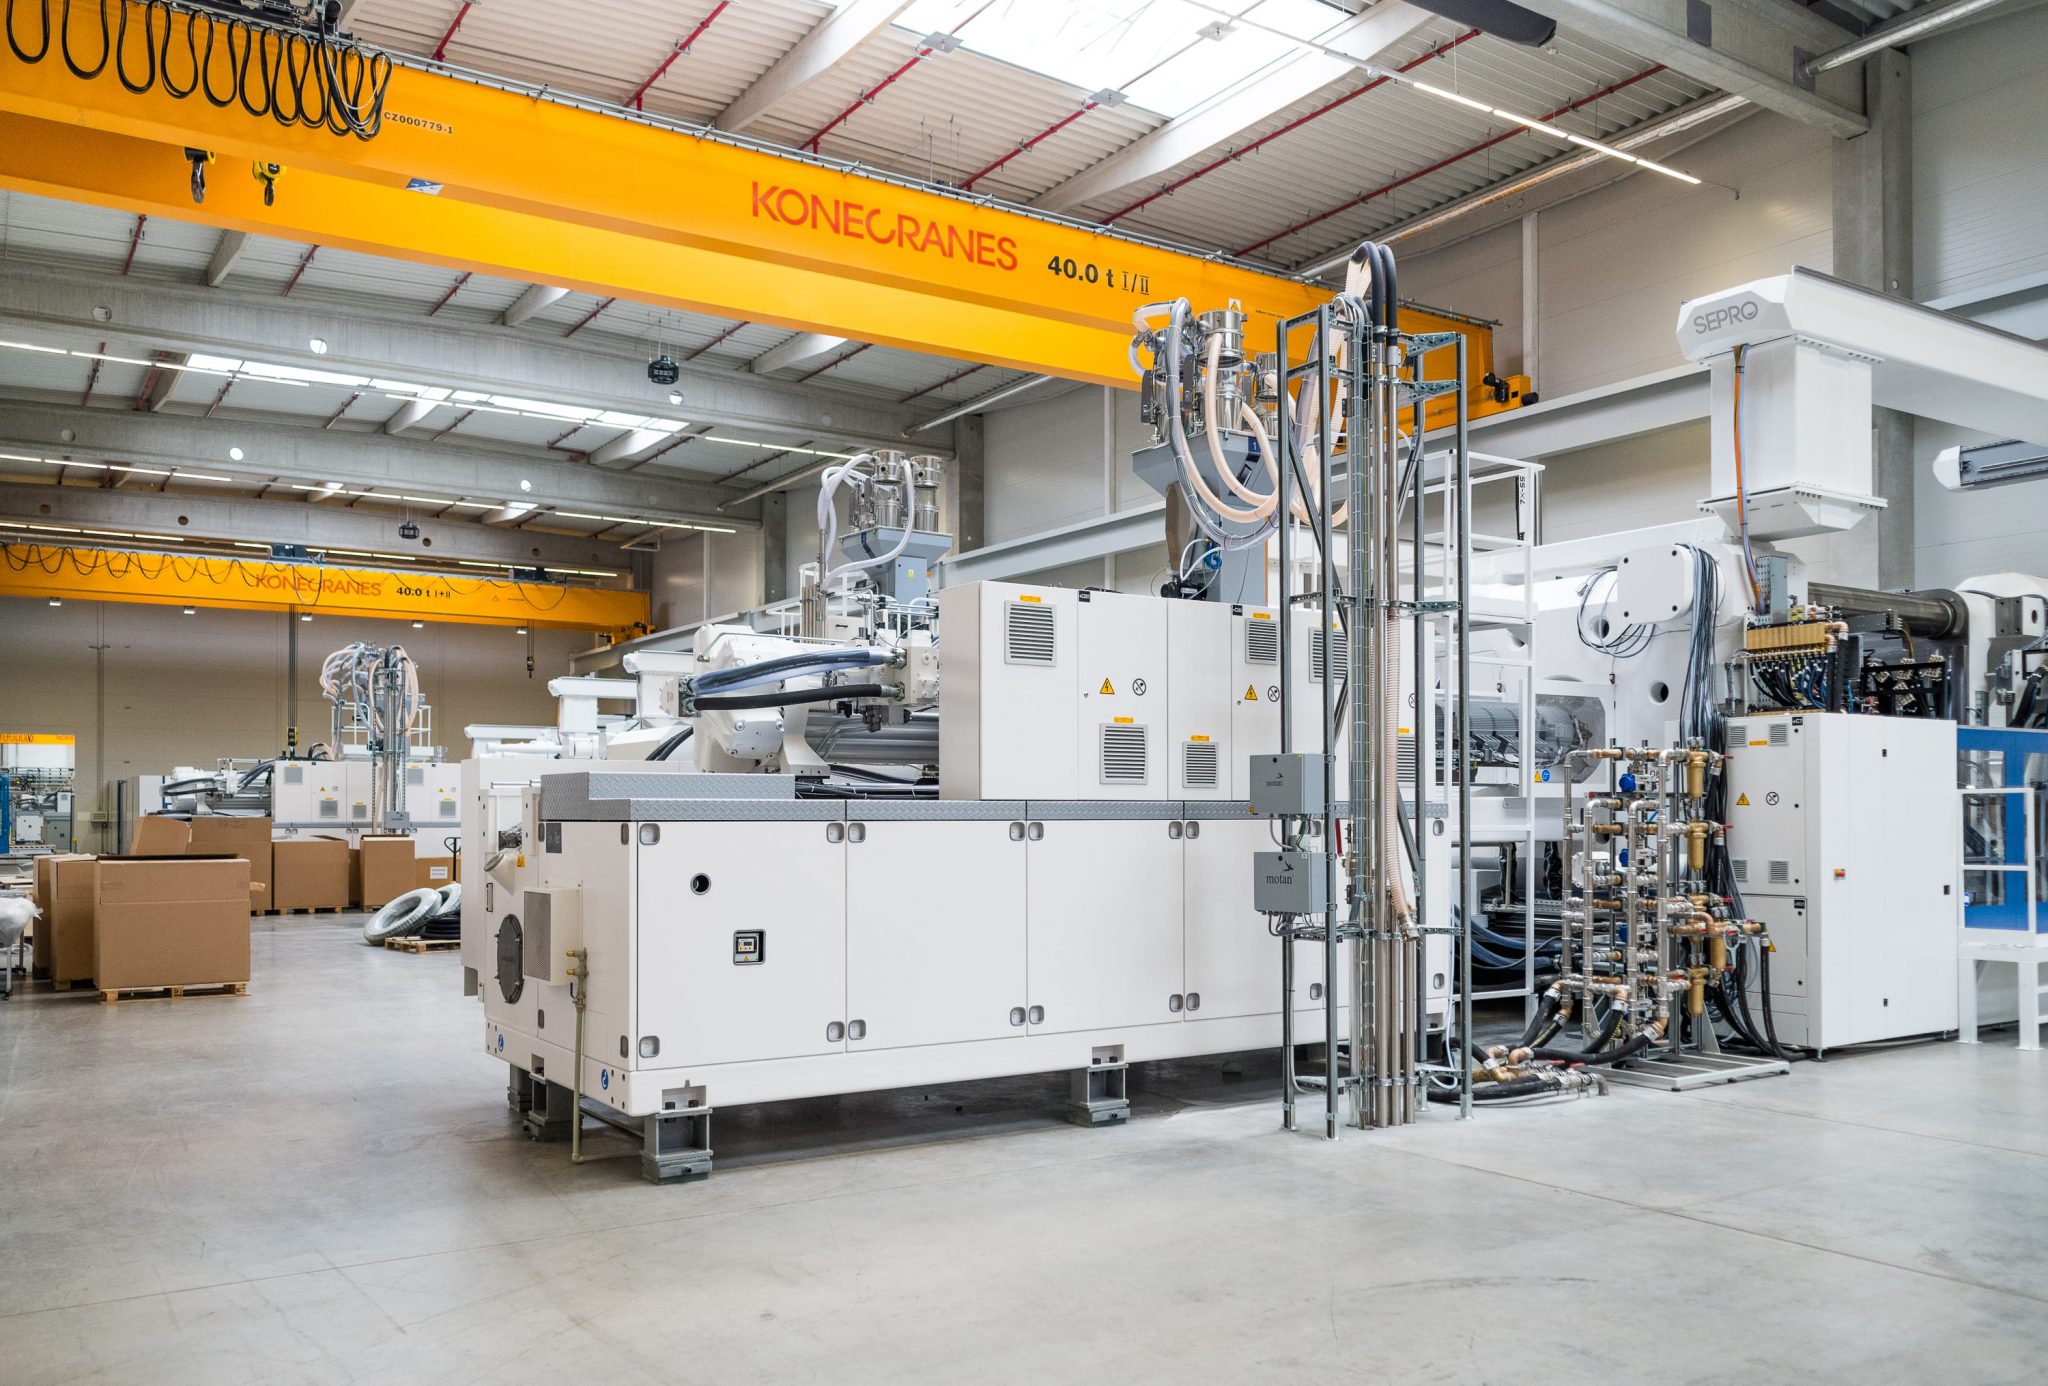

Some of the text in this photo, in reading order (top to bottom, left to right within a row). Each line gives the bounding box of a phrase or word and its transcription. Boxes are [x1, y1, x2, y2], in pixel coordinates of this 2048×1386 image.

[383, 111, 453, 134] CZ000779-1
[752, 181, 1018, 271] KONECRANES
[1047, 255, 1099, 284] 40.0
[1106, 268, 1114, 288] t
[1693, 301, 1759, 334] SEPRO
[255, 574, 382, 597] KONECRANES
[396, 587, 422, 597] 40.0
[1265, 875, 1293, 885] motan
